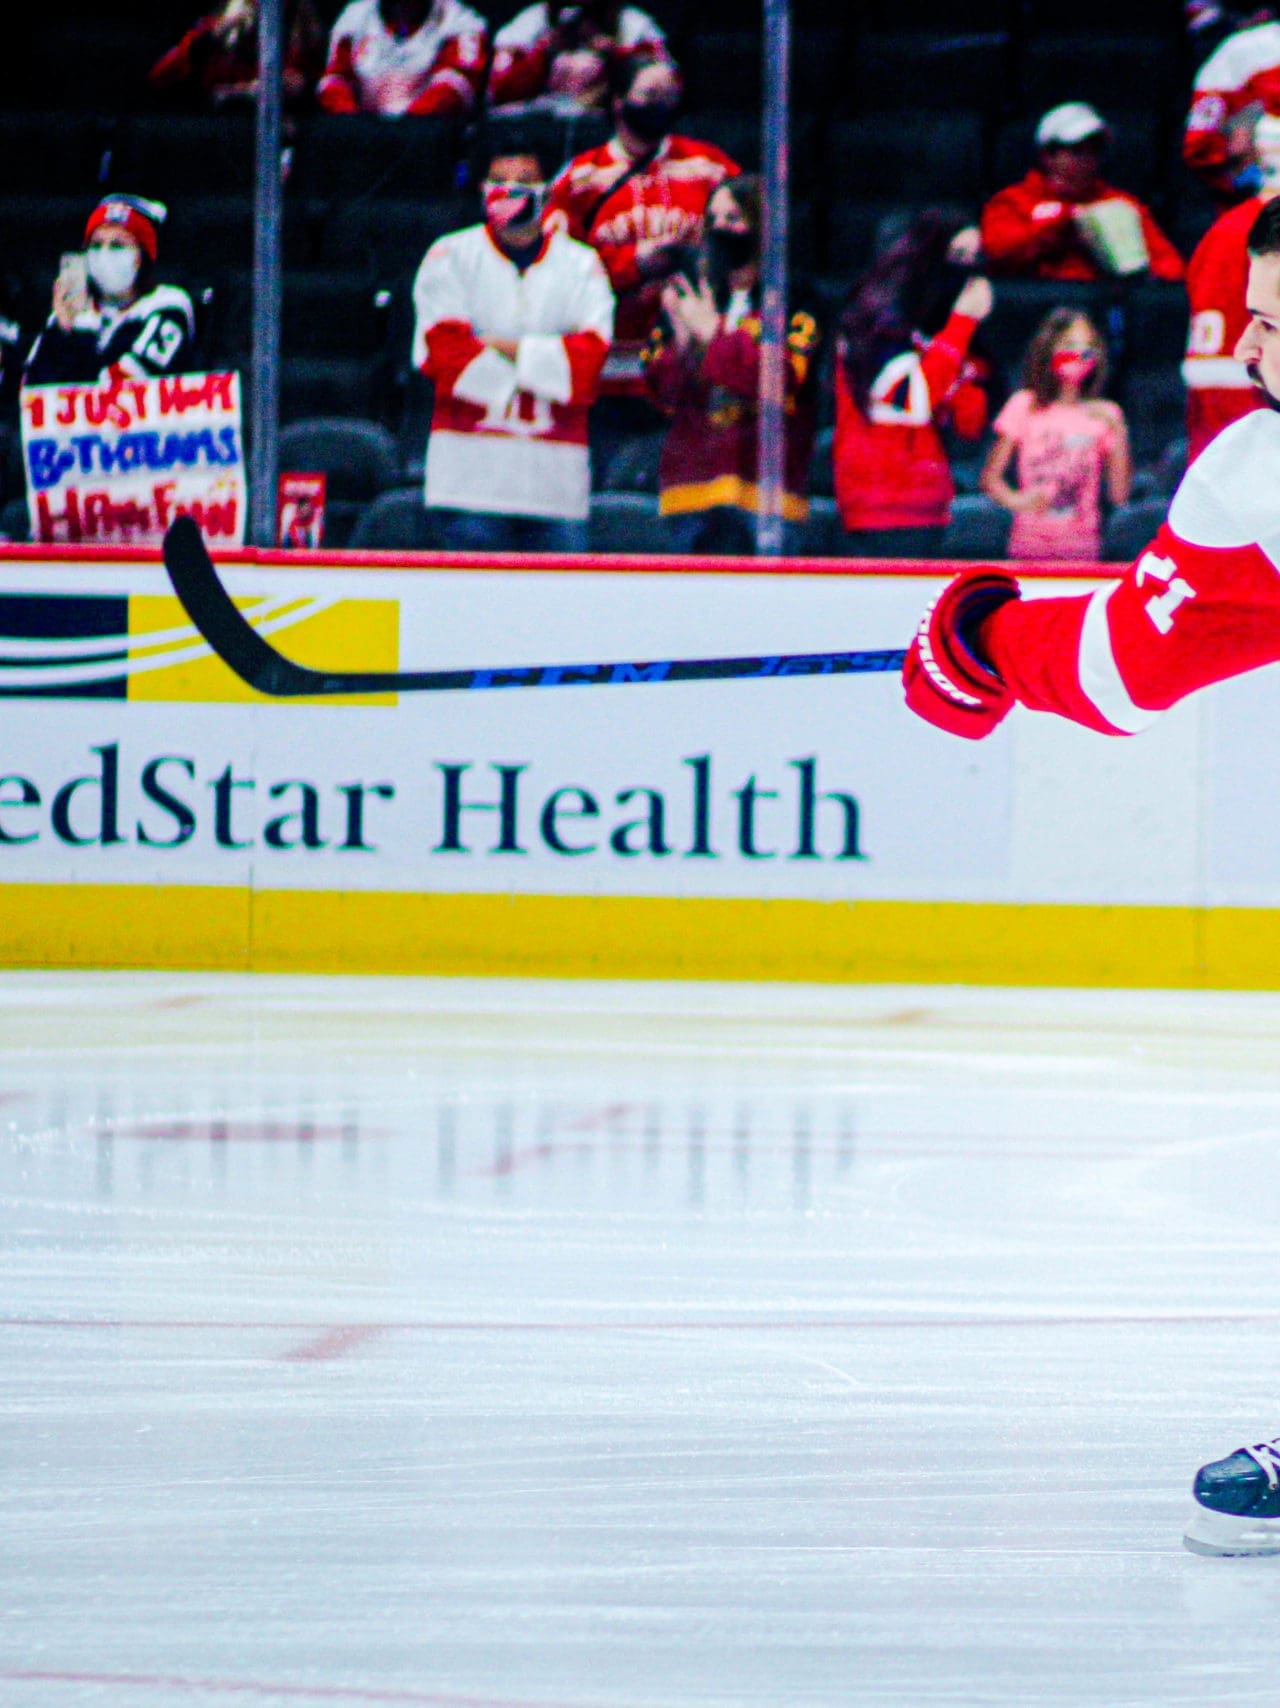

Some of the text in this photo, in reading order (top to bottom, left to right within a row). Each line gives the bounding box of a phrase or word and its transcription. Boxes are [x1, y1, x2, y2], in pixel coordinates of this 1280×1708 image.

[133, 308, 185, 369] 13
[469, 660, 673, 690] CCM
[430, 751, 871, 862] Health
